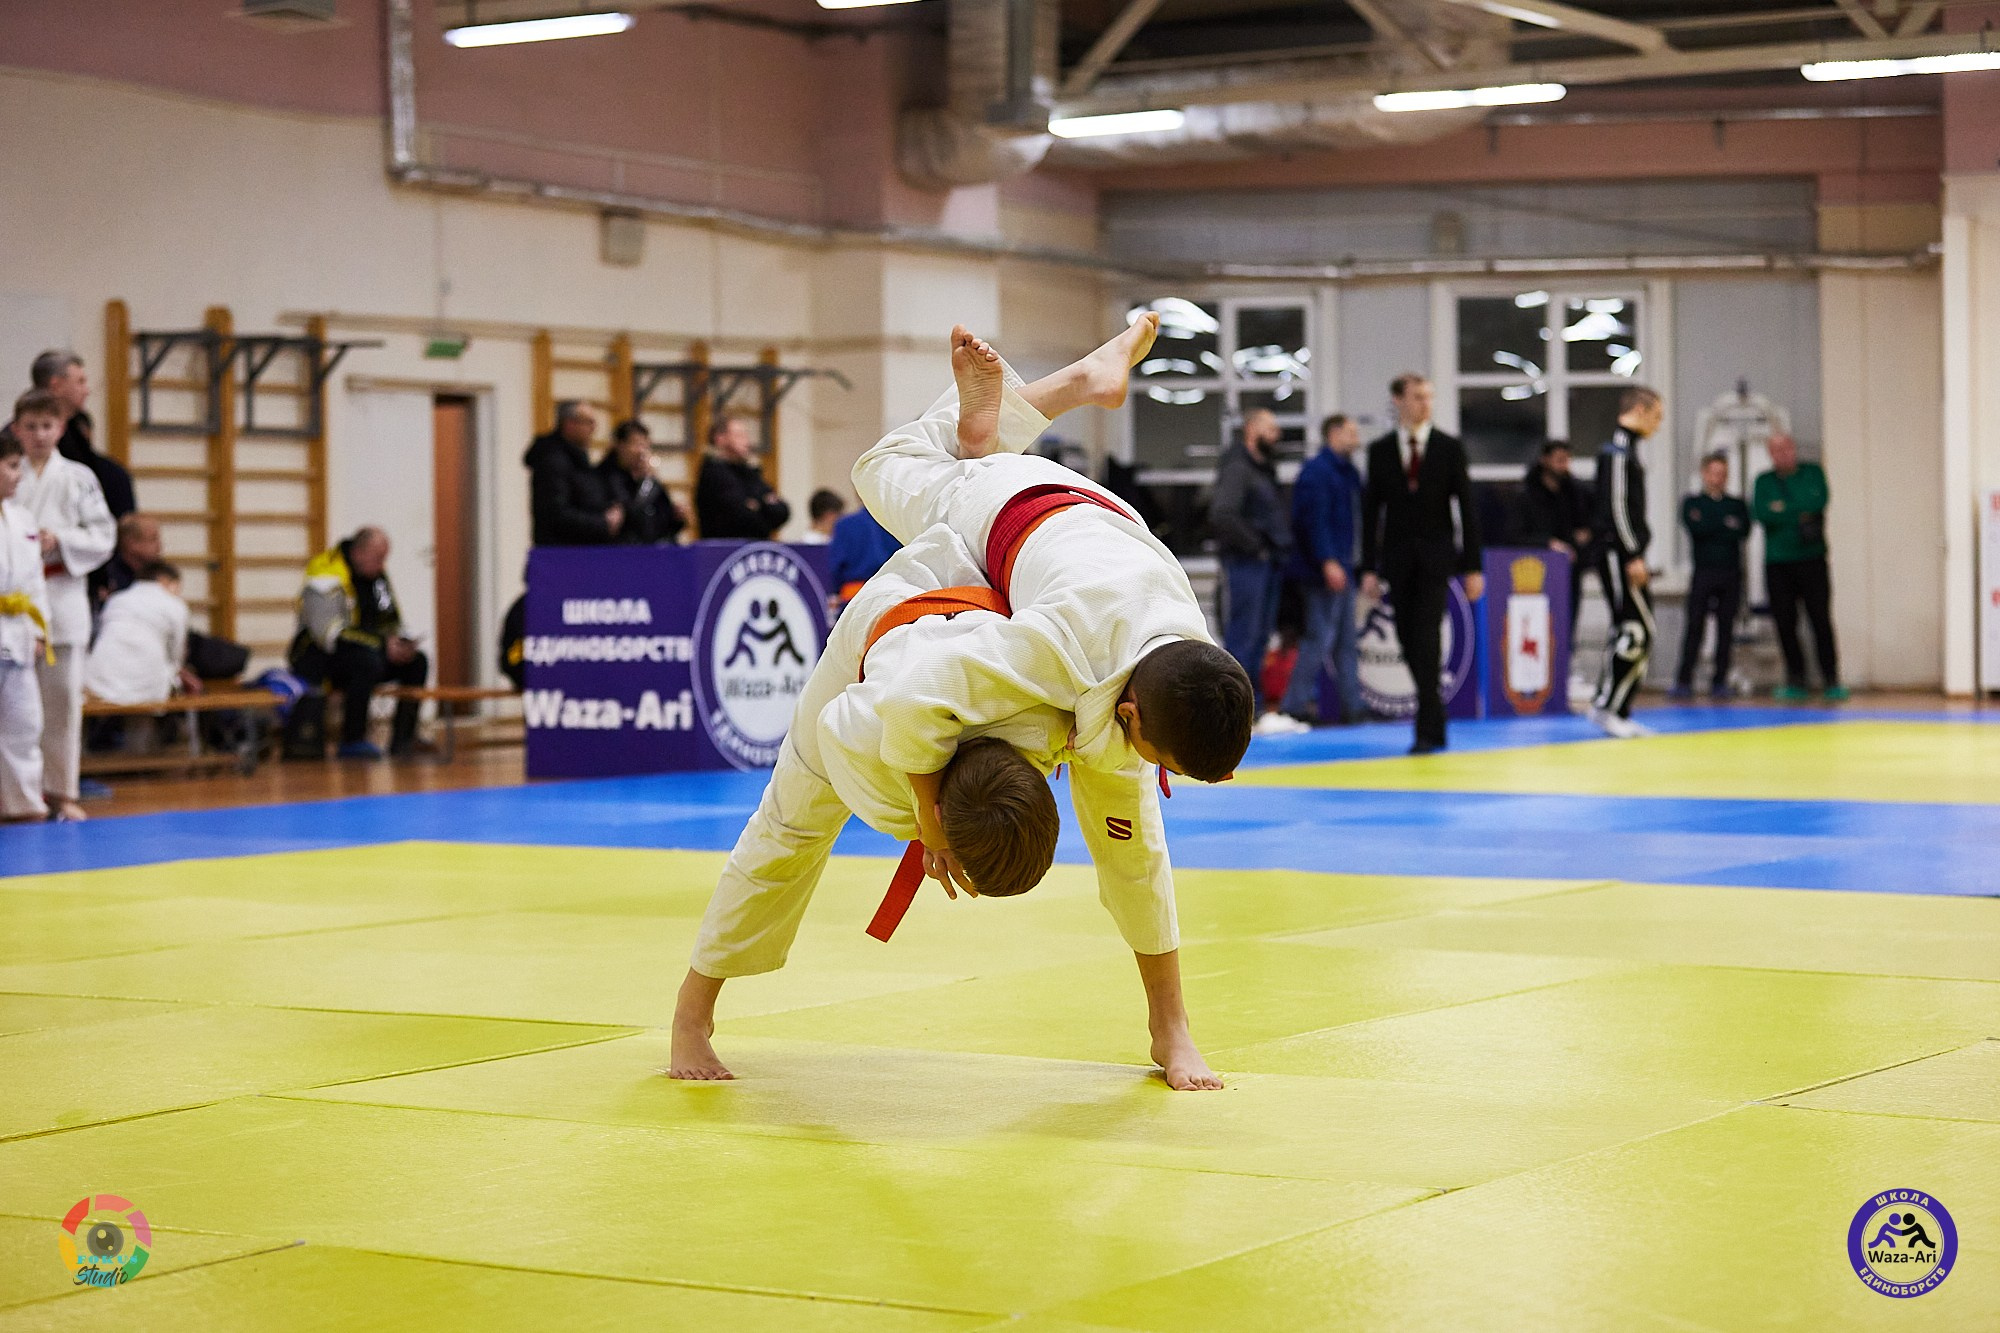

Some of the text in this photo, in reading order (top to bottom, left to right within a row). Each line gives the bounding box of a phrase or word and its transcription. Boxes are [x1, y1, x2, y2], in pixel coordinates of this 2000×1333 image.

[562, 598, 652, 625] ШКОЛА
[523, 635, 693, 666] ЕДИНОБОРСТВ
[523, 690, 694, 731] Waza-Ari
